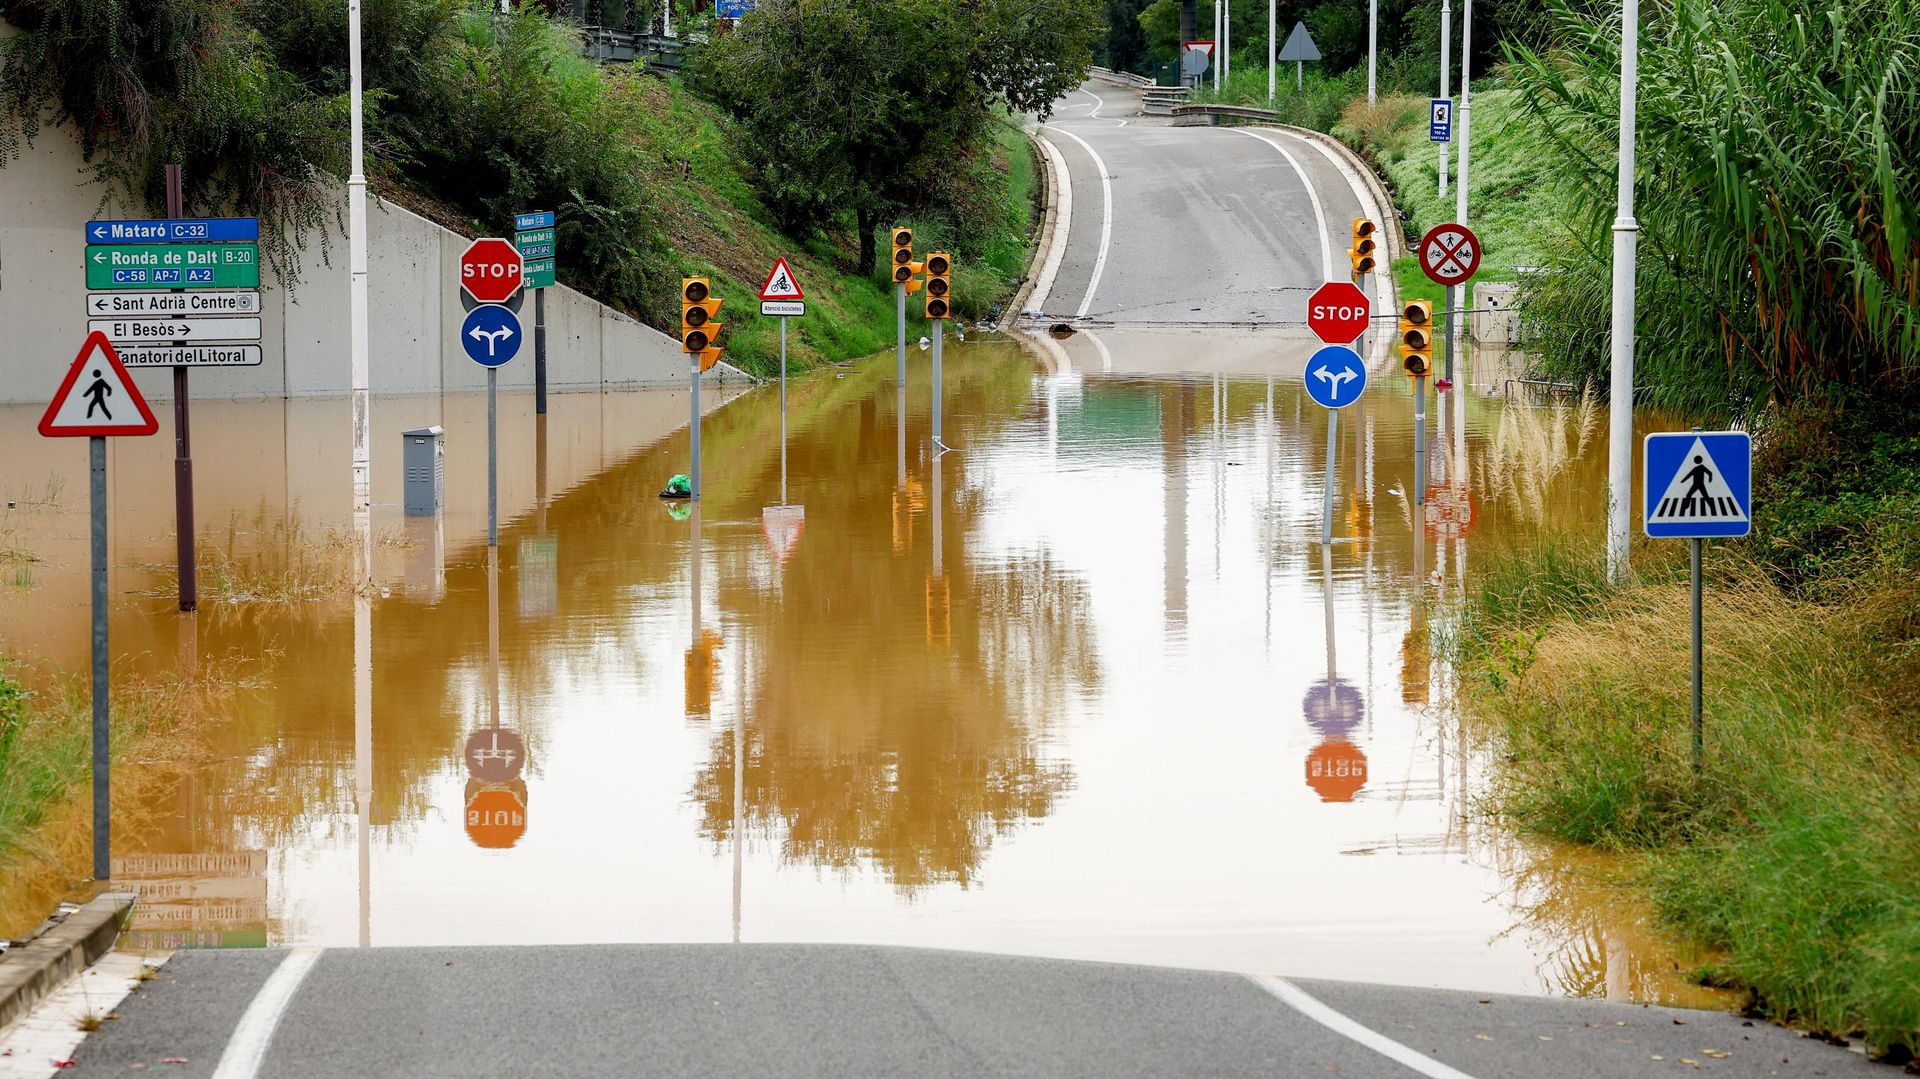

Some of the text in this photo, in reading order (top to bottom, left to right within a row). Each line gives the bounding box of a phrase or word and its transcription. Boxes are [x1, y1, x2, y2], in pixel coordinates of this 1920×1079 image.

[111, 224, 205, 238] Mataró C-32
[112, 250, 250, 265] Ronda de Dalt B-20
[116, 270, 211, 281] C-58 AP-7 A-2
[463, 263, 519, 278] STOP
[524, 264, 532, 274] onda
[113, 296, 236, 311] Sant Adrià Centre
[1312, 306, 1365, 320] STOP
[114, 322, 175, 336] El Besòs
[175, 349, 197, 363] del
[199, 348, 246, 362] Litoral
